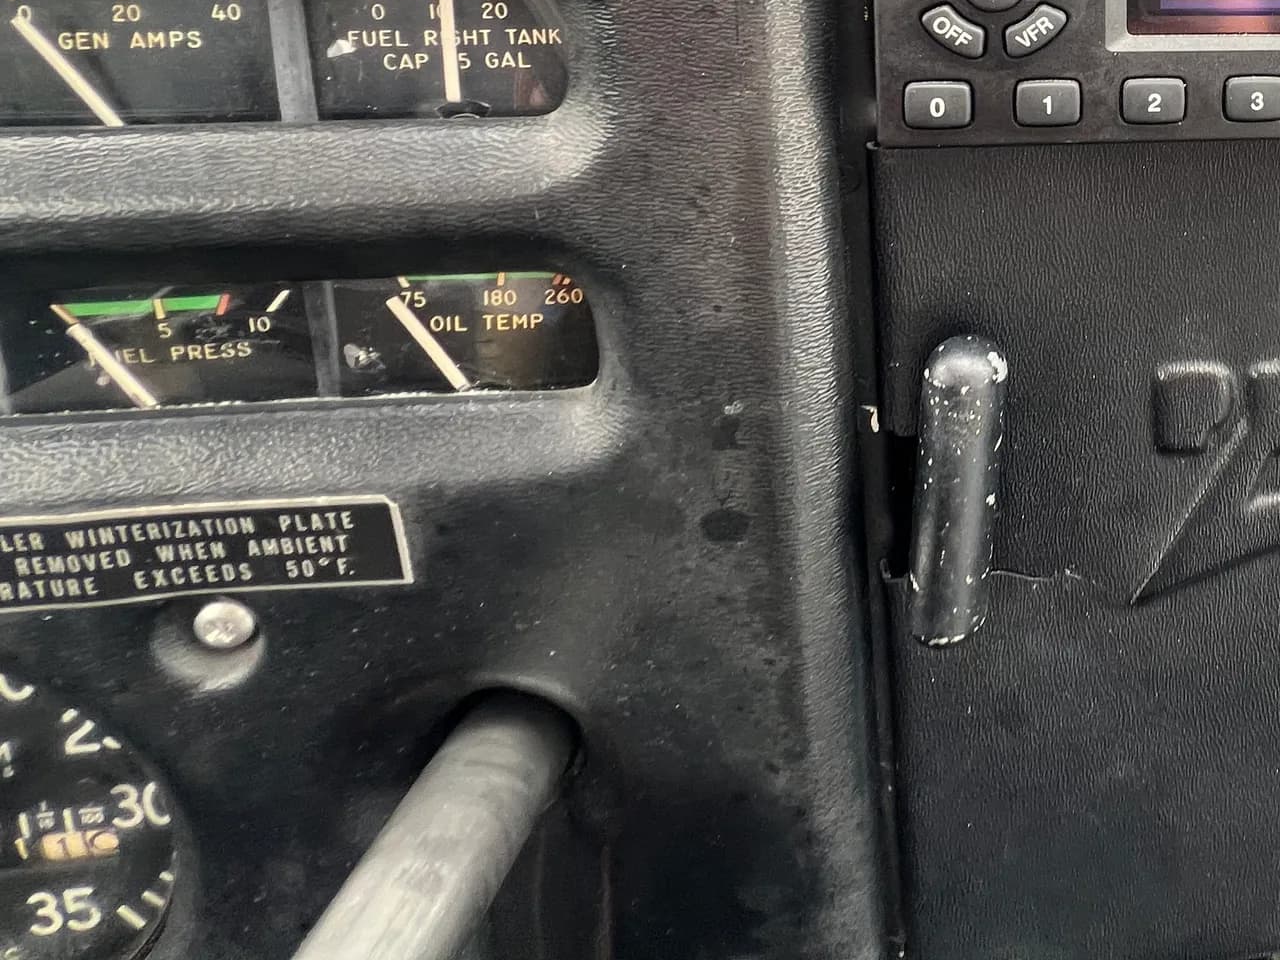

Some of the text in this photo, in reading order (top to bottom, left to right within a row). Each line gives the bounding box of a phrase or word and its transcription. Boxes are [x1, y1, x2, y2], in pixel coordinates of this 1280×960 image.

[112, 4, 141, 23] 20
[211, 3, 241, 21] 40
[371, 3, 385, 21] 0
[481, 2, 508, 20] 20
[58, 30, 203, 50] GEN AMPS
[348, 30, 409, 48] FUEL
[505, 28, 562, 46] TANK
[932, 16, 973, 49] OFF
[1014, 15, 1055, 49] VFR
[383, 53, 429, 71] CAP
[485, 51, 531, 69] GAL
[929, 96, 946, 119] 0
[1042, 95, 1054, 116] 1
[1147, 93, 1162, 113] 2
[1250, 91, 1265, 112] 3
[399, 290, 426, 309] 75
[483, 289, 517, 307] 180
[544, 288, 584, 306] 260
[158, 323, 172, 339] 5
[249, 316, 271, 333] 10
[430, 313, 544, 333] OIL TEMP
[170, 341, 252, 361] PRESS
[64, 516, 255, 550] WINTERIZATION
[279, 511, 354, 533] PLATE
[14, 534, 349, 576] REMOVED WHEN AMBIENT
[133, 562, 253, 590] EXCEEDS
[26, 886, 102, 936] 35
